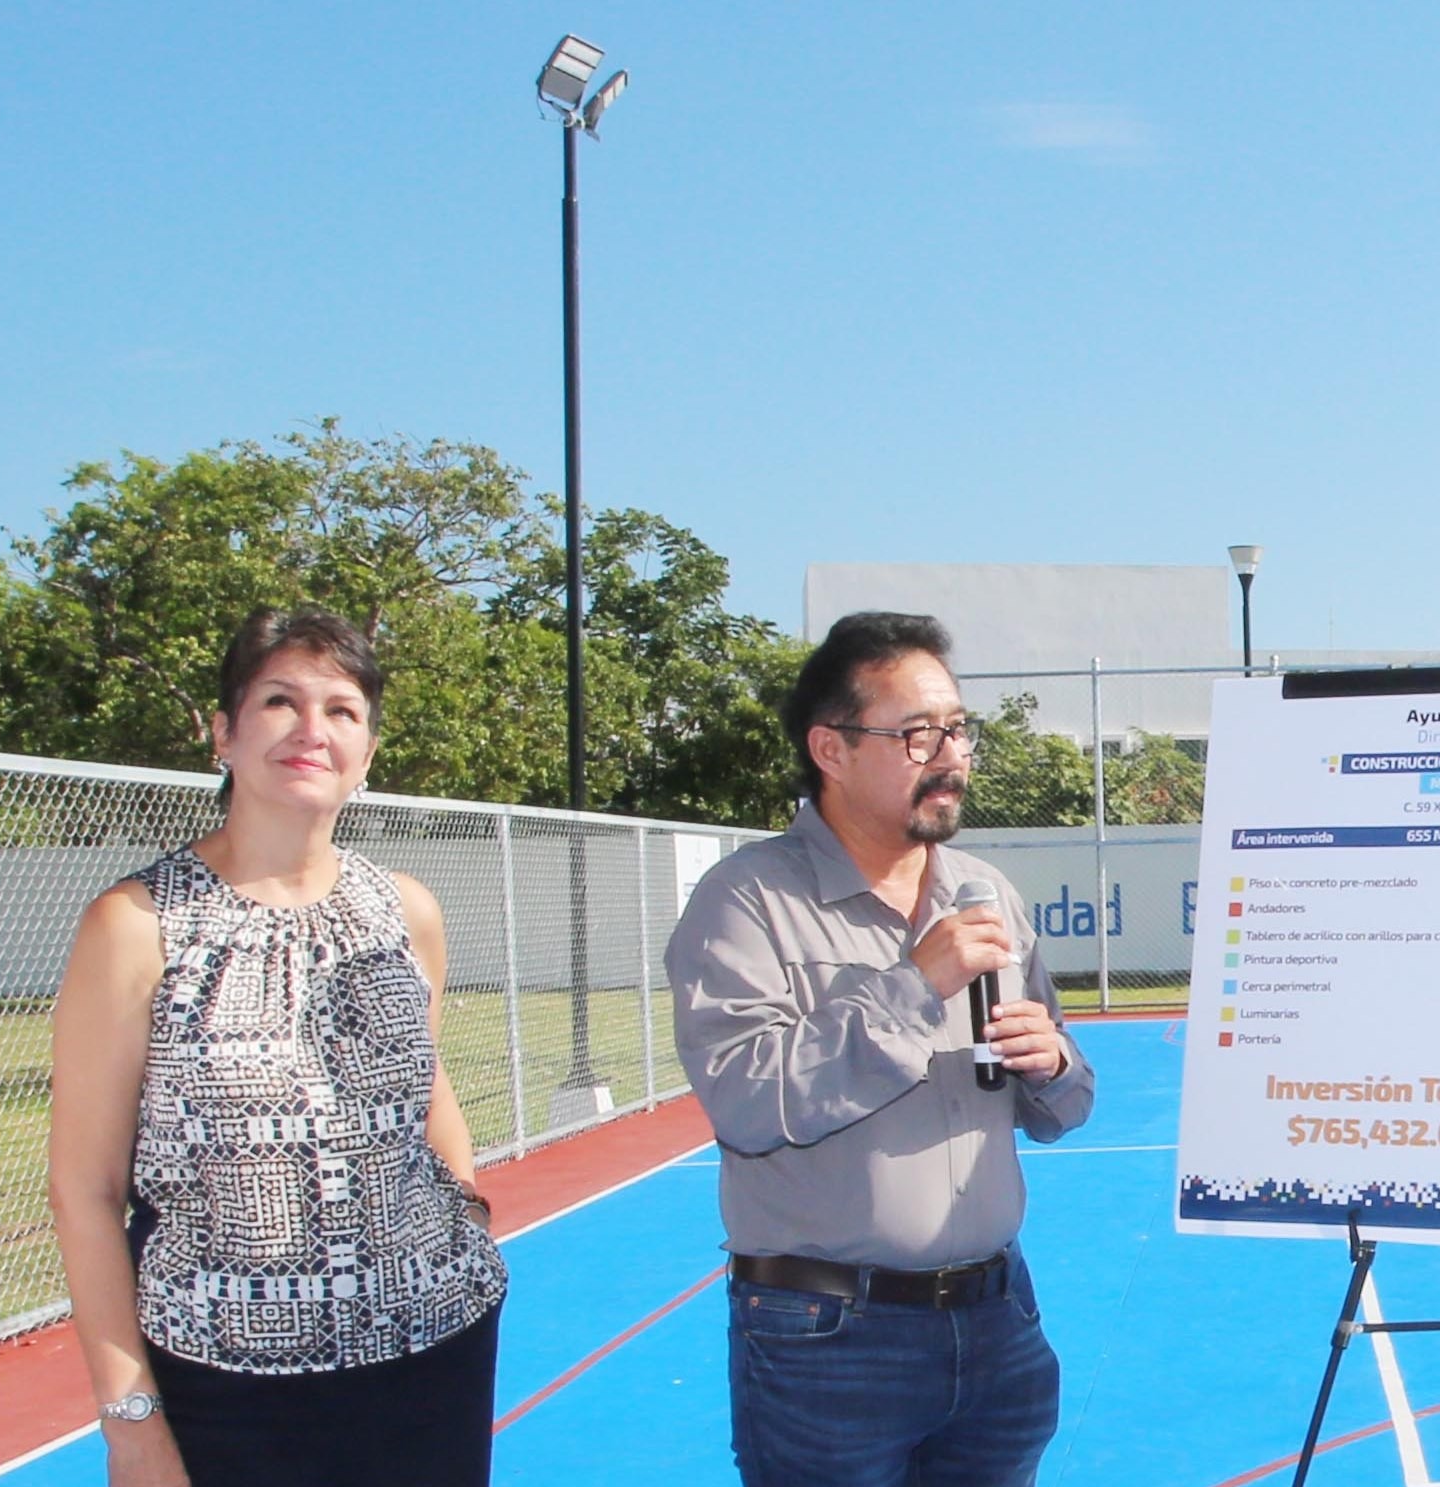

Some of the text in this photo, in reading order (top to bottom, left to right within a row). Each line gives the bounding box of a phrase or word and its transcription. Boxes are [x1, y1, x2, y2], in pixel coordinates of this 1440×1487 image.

[1416, 802, 1431, 812] 59
[1236, 830, 1265, 846] Área
[1266, 831, 1334, 845] intervenida
[1406, 830, 1432, 843] 655
[1249, 878, 1272, 889] Piso
[1289, 879, 1337, 889] concreto
[1339, 877, 1418, 890] pre-mezclado
[1247, 903, 1305, 914] Andadores
[1246, 930, 1286, 941] Tablero
[1287, 930, 1301, 941] de
[1345, 932, 1365, 942] con
[1367, 930, 1403, 941] arillos
[1405, 932, 1432, 944] para
[1244, 954, 1283, 965] Pintura
[1285, 953, 1338, 967] deportiva
[1241, 982, 1272, 992] Cerca
[1273, 981, 1331, 995] perimetral
[1240, 1008, 1300, 1020] Luminarias
[1266, 1074, 1413, 1102] Inversión
